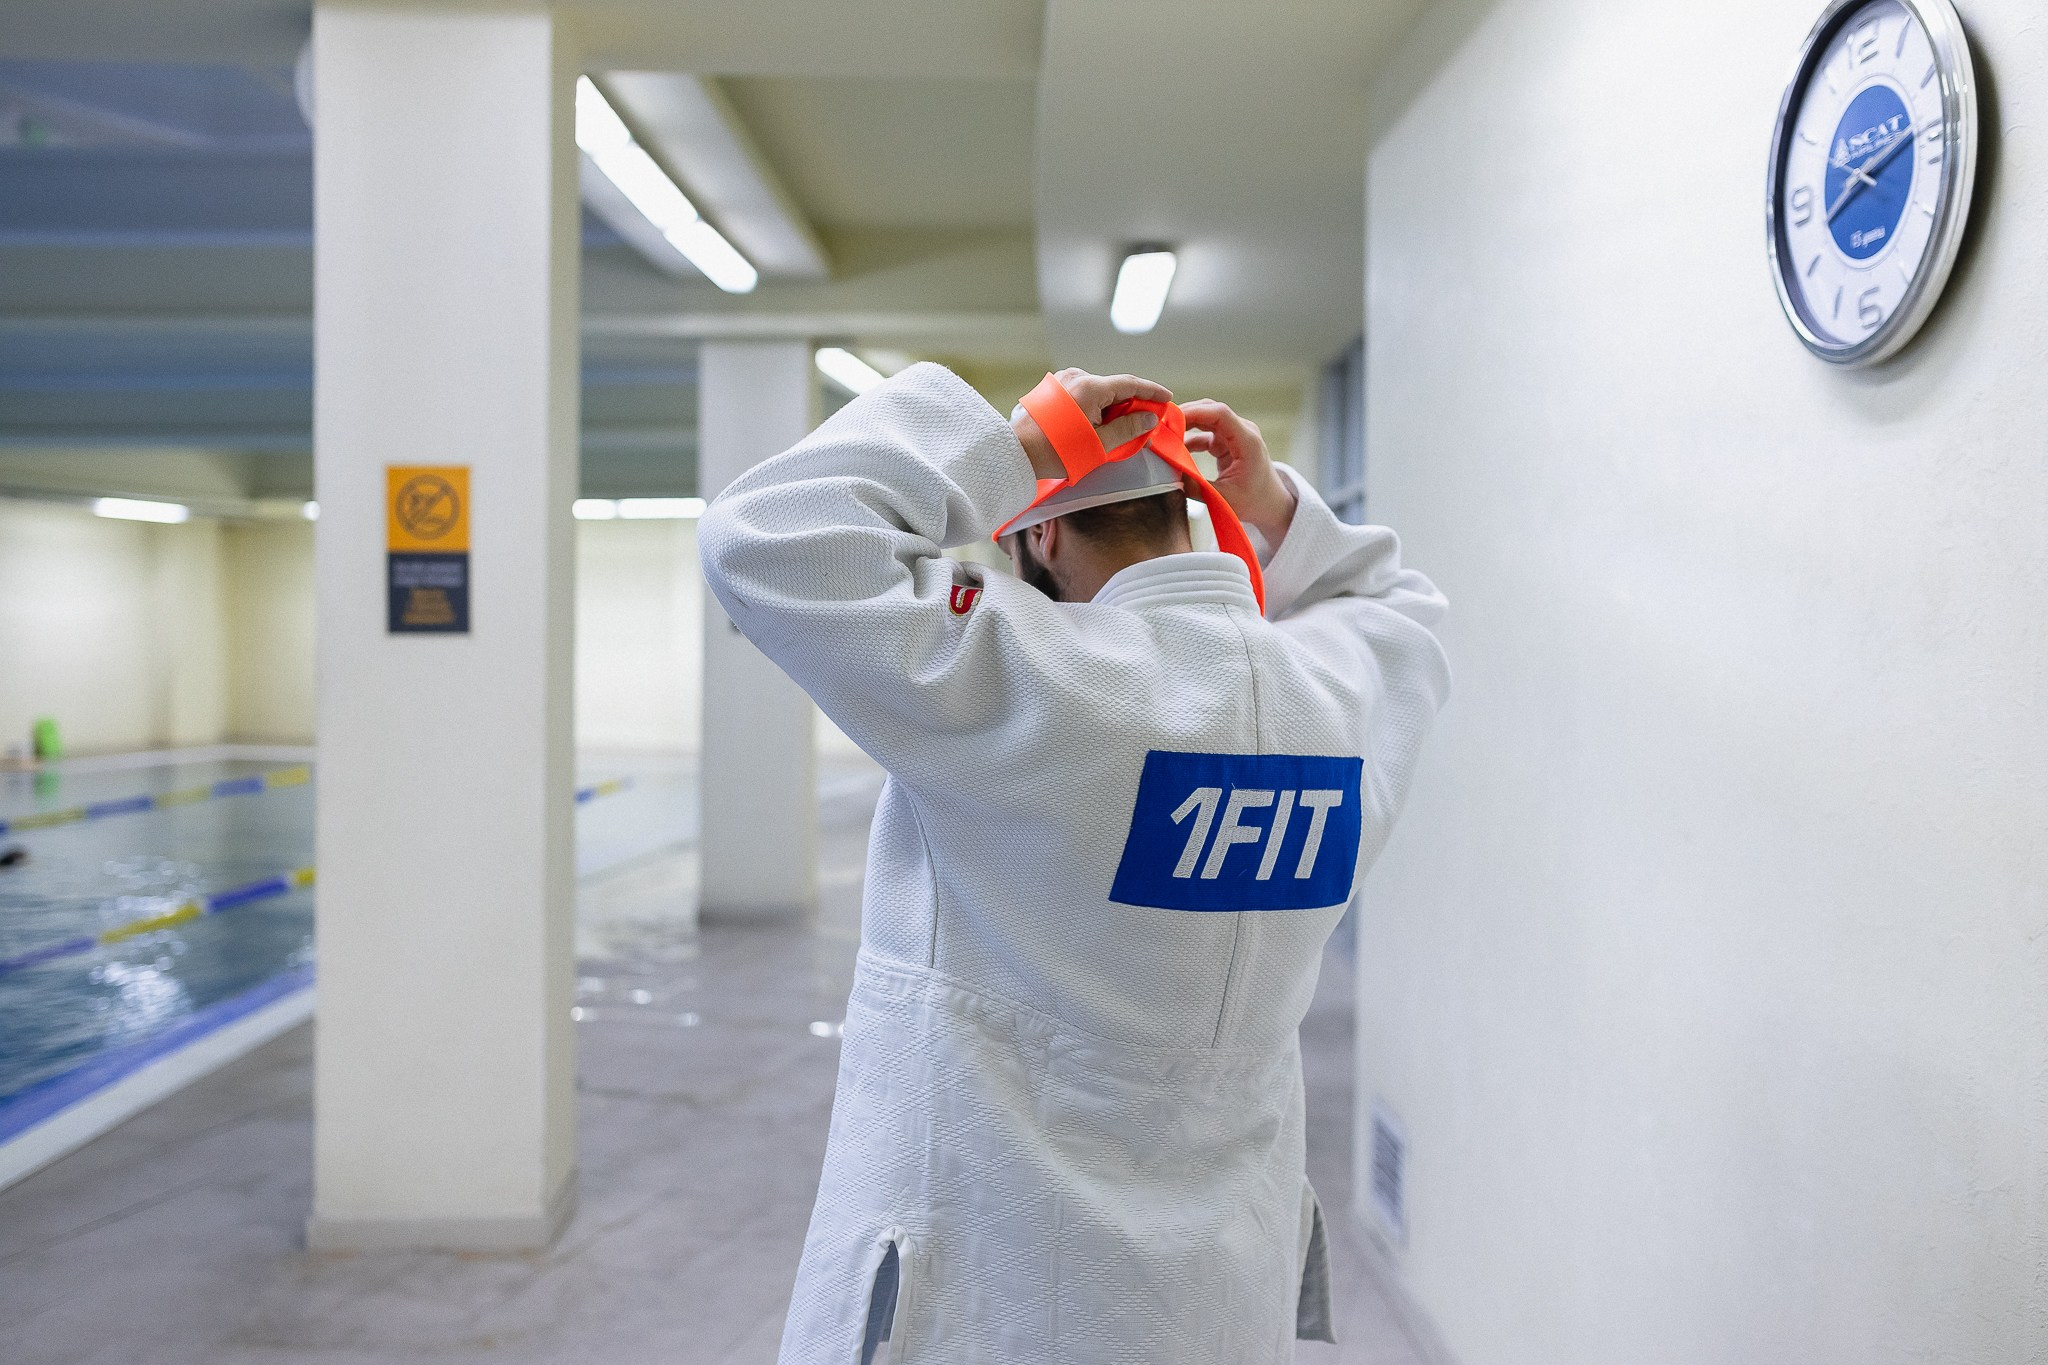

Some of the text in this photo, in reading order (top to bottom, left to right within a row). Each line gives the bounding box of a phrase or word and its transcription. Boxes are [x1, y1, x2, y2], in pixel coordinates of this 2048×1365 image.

[1791, 184, 1814, 228] 9
[1858, 285, 1883, 331] 6
[1170, 787, 1344, 881] 1FIT
